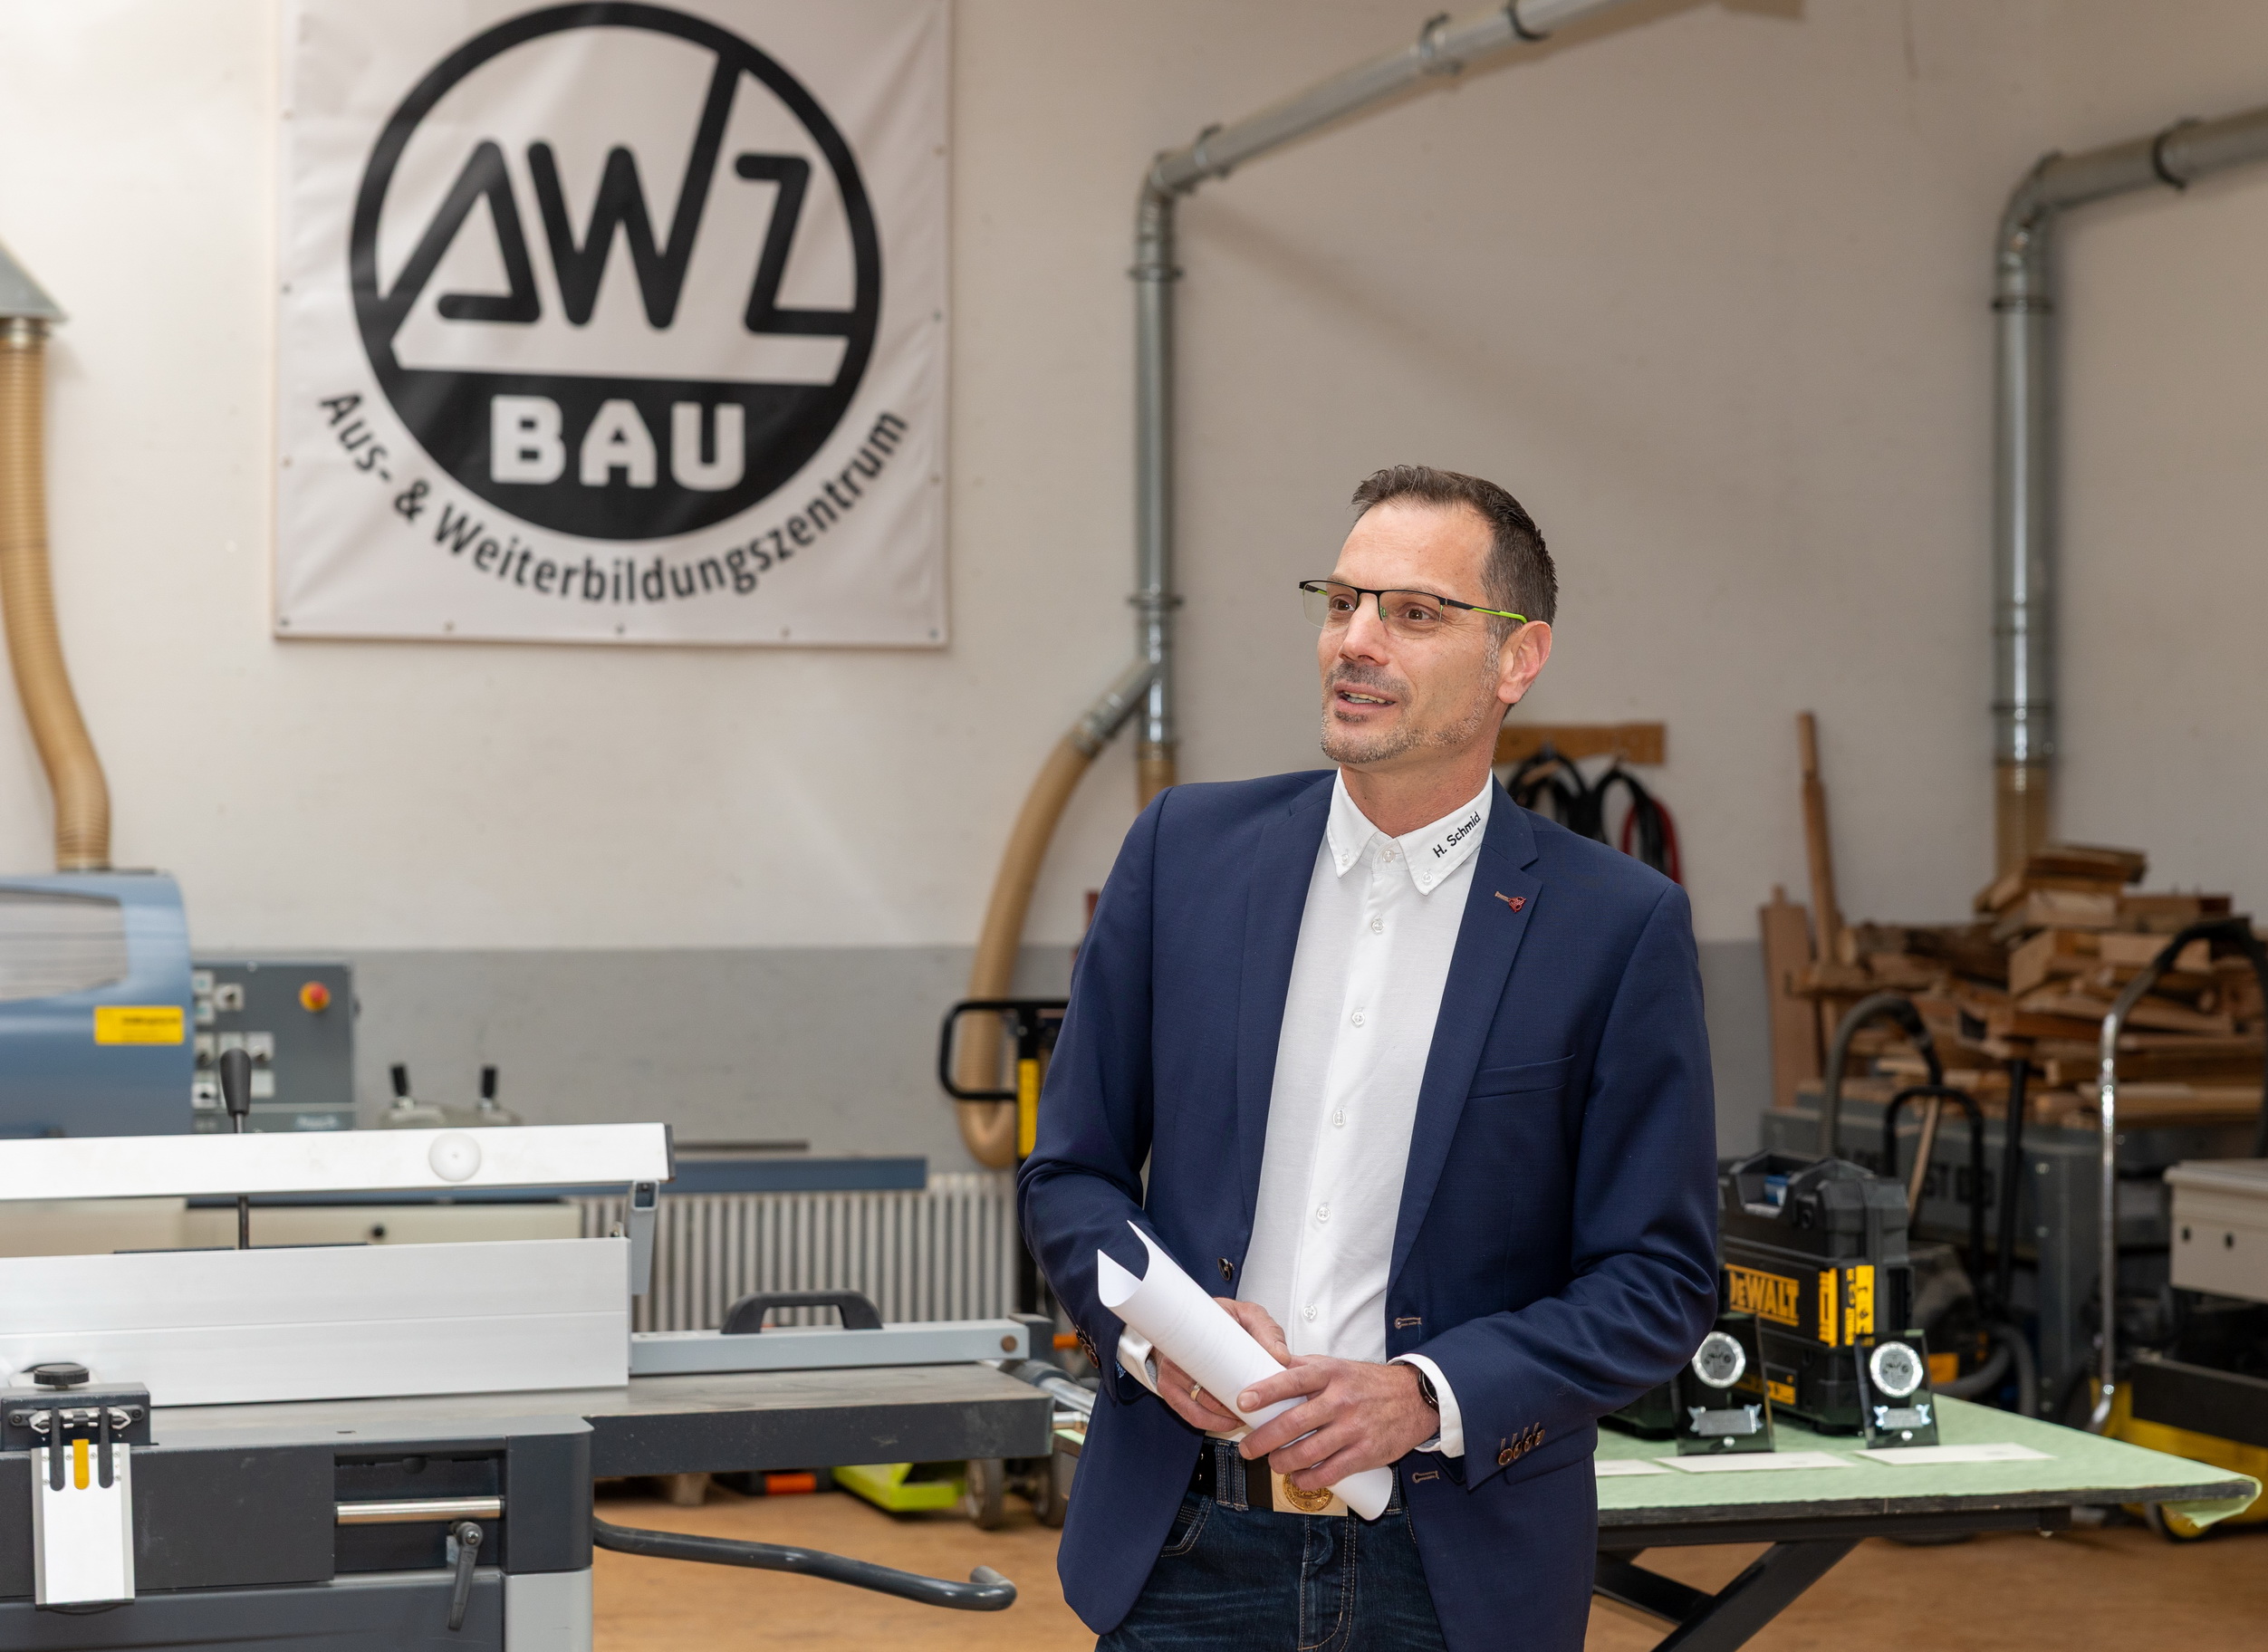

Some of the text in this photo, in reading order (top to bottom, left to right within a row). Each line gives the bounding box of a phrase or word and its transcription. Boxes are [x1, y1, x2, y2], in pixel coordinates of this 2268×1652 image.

[370, 139, 857, 335] AWZ
[320, 392, 908, 602] Aus- & Weiterbildungszentrum
[491, 395, 745, 491] BAU
[1432, 811, 1481, 858] H. Schmid
